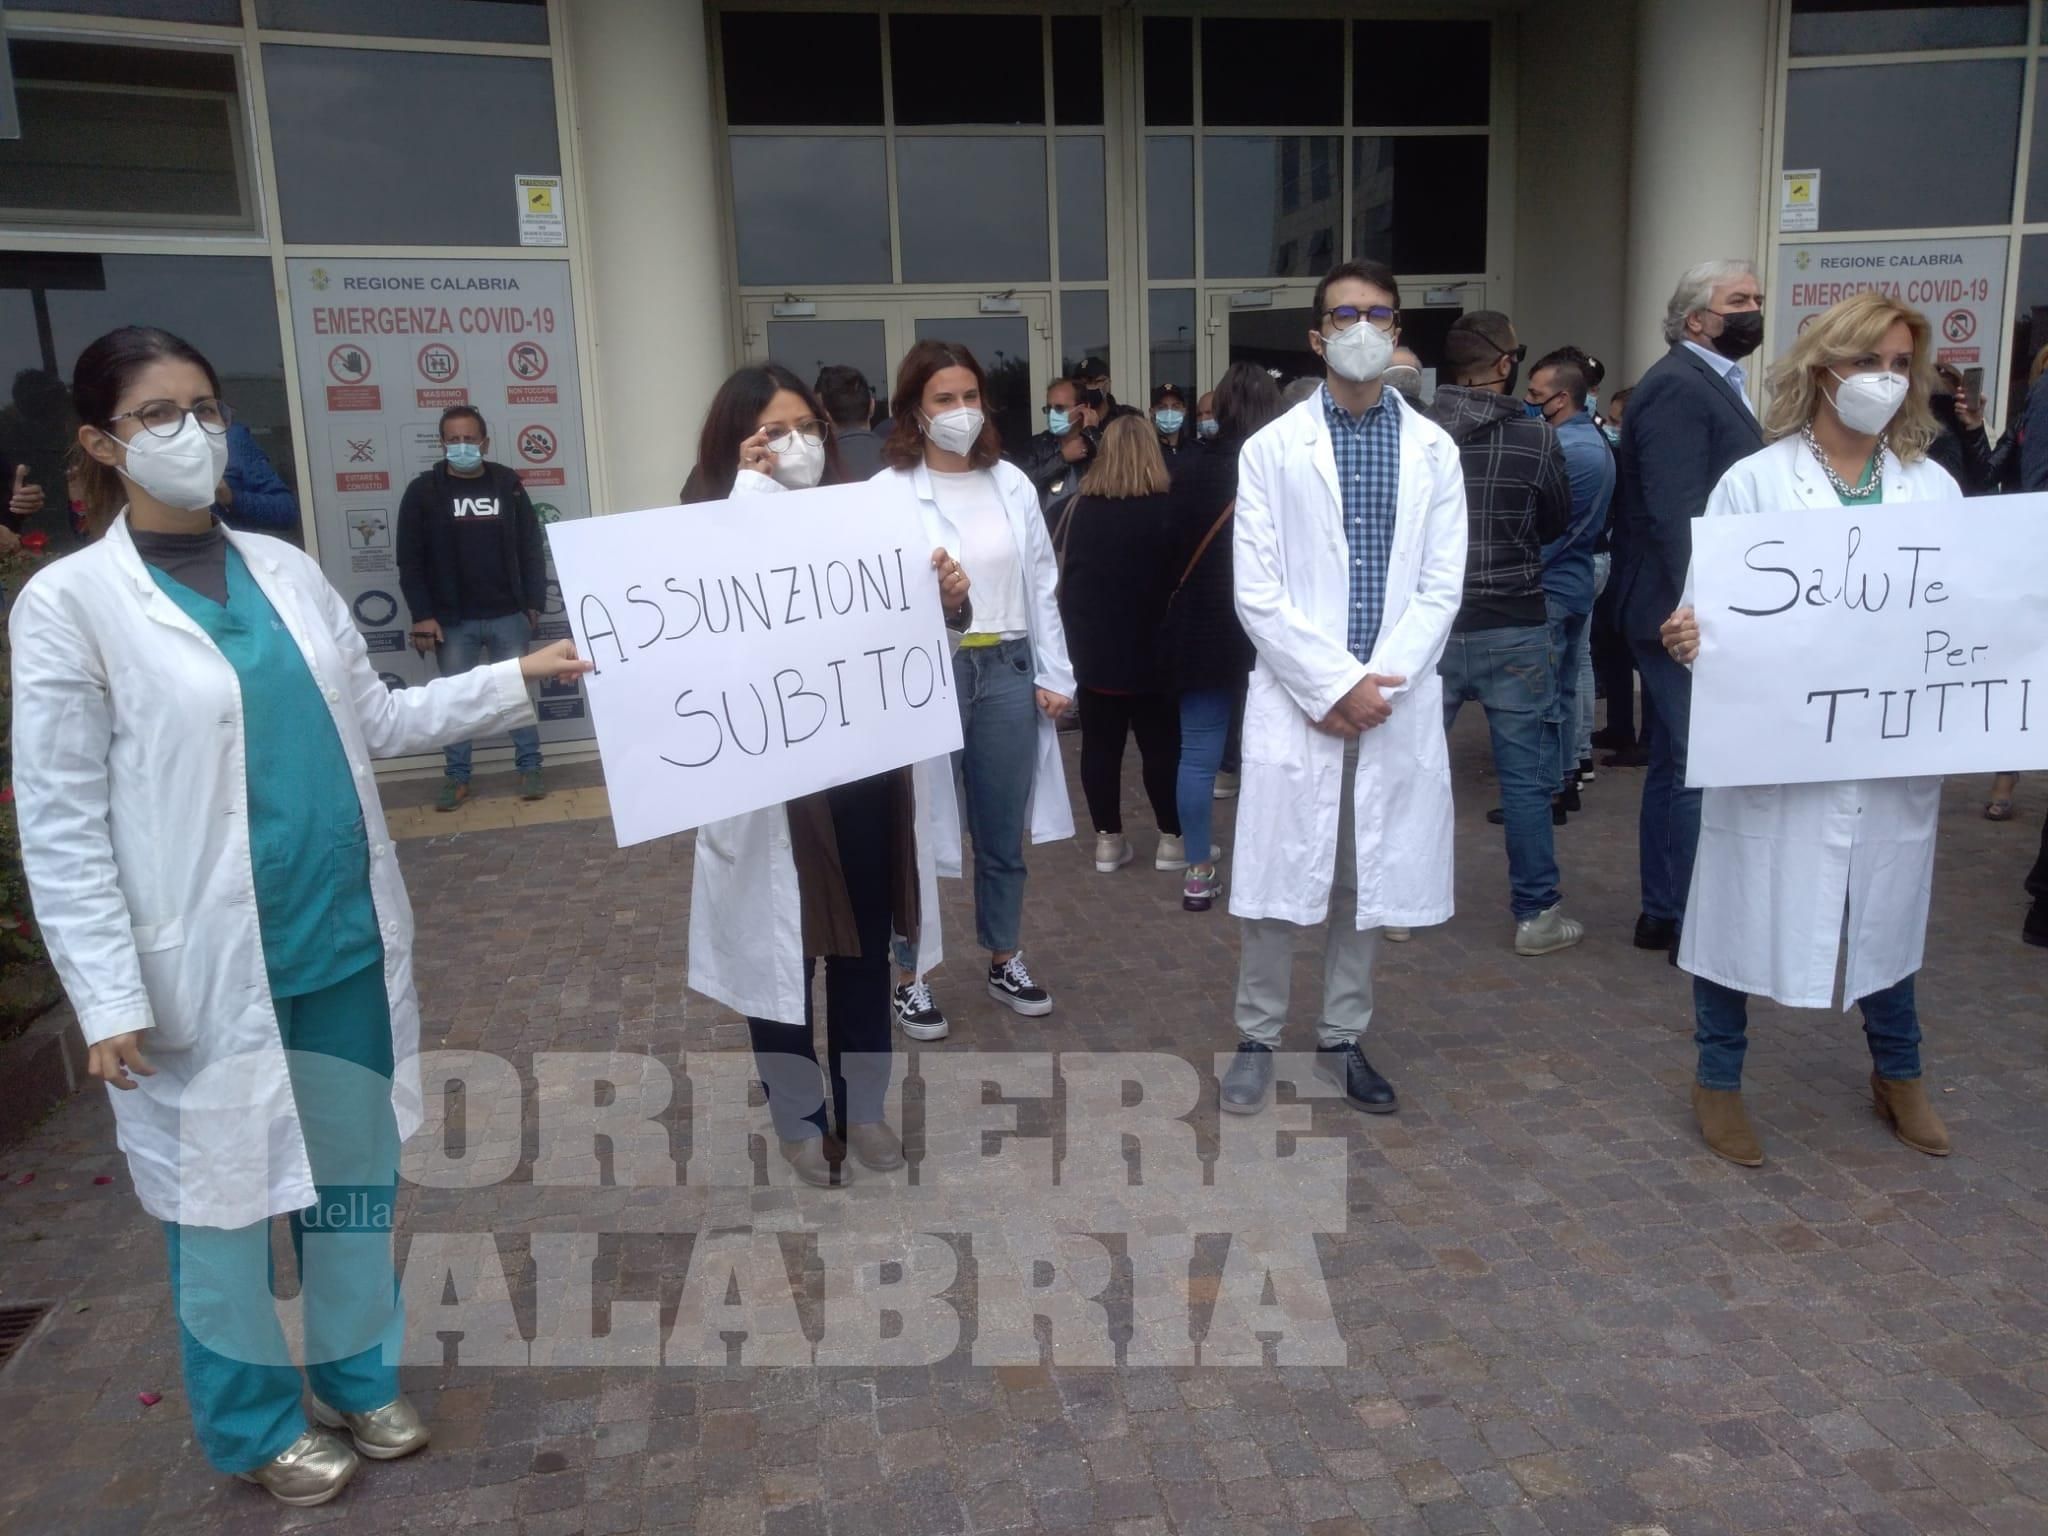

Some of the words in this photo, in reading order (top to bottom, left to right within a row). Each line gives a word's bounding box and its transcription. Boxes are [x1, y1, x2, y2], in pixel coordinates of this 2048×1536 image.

[1820, 256, 1885, 269] REGIONE
[1889, 254, 1963, 267] CALABRIA
[344, 277, 424, 290] REGIONE
[430, 277, 520, 291] CALABRIA
[1907, 278, 1988, 303] COVID-19
[313, 307, 453, 334] EMERGENZA
[459, 307, 555, 334] COVID-19
[580, 548, 911, 675] ASSUNZIONI
[660, 640, 947, 768] SUBITO!
[1807, 679, 2031, 743] TUTTI
